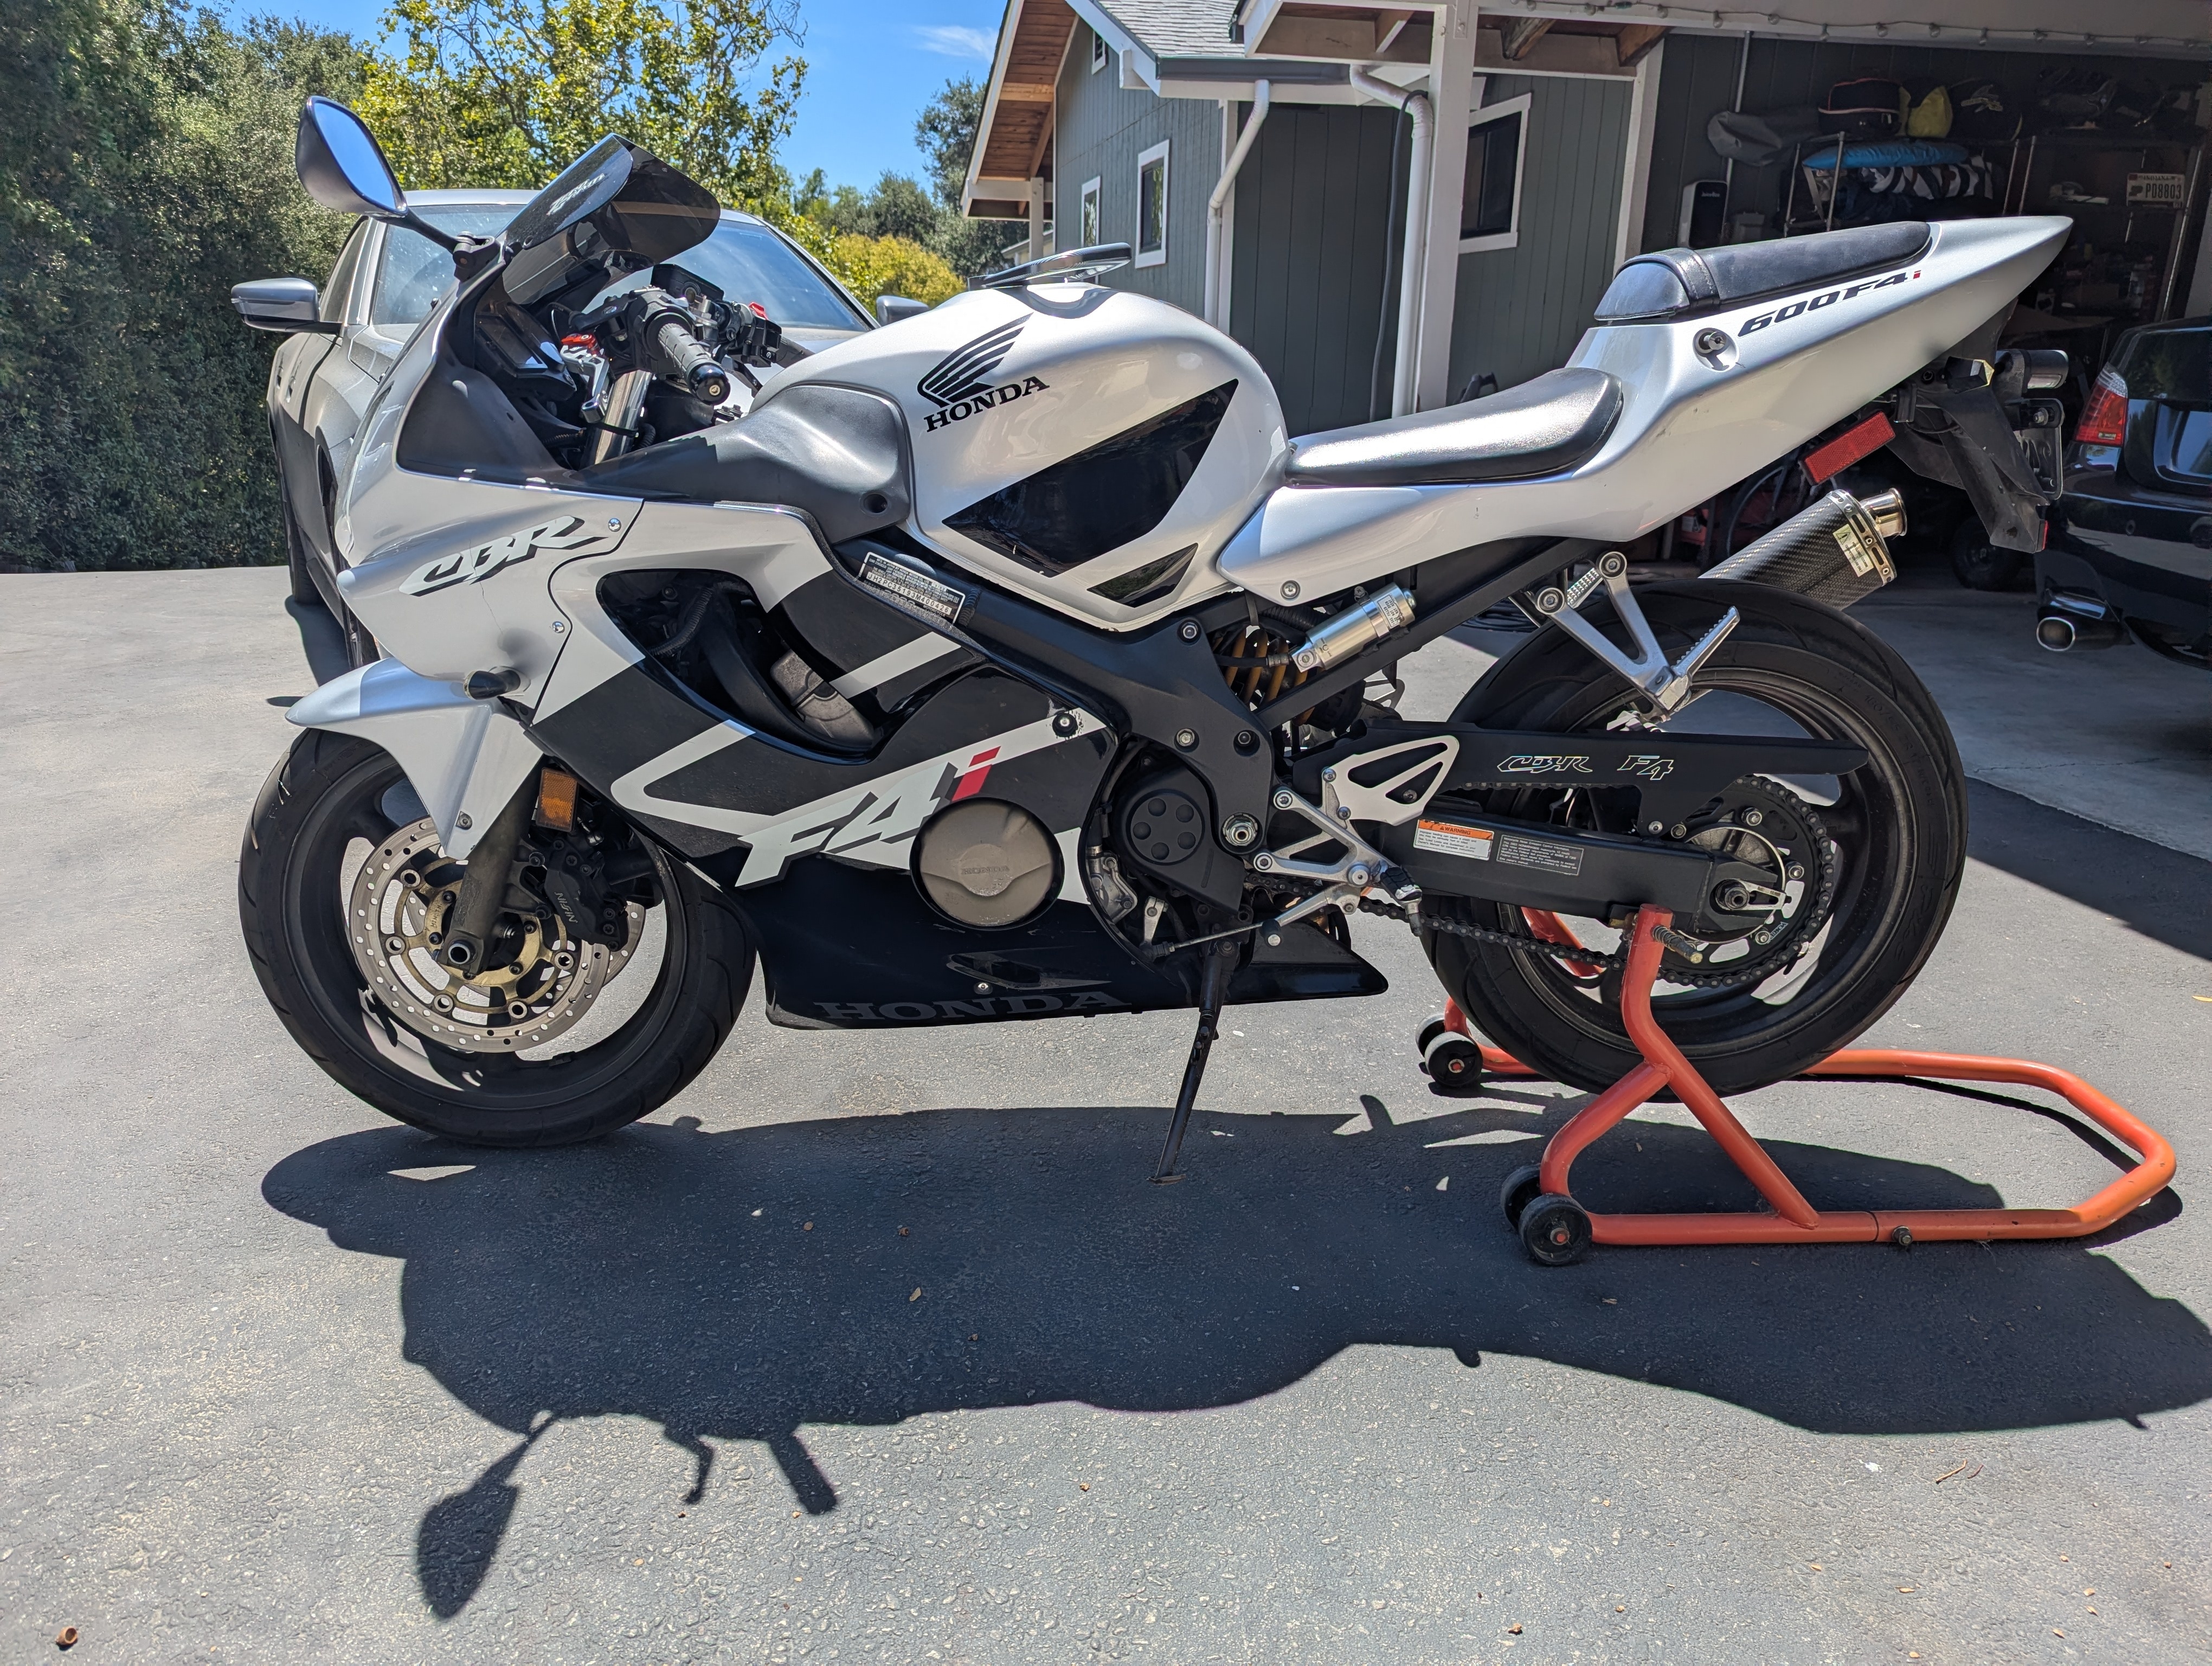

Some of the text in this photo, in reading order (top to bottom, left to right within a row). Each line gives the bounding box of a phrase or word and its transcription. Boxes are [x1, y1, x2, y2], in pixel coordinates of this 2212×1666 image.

[2145, 183, 2182, 199] PD8803
[1738, 270, 1921, 337] 600F4i
[923, 376, 1050, 432] HONDA
[398, 515, 608, 597] CBR
[867, 573, 949, 613] JH2PC35193M400426
[922, 604, 946, 617] MOTORCYCLE
[1497, 755, 1674, 780] CBR F4
[735, 746, 1001, 889] F4i
[1444, 826, 1471, 835] WARNING
[554, 892, 578, 923] NISSIN
[1768, 922, 1787, 938] VORTE
[813, 991, 1134, 1021] HONDA
